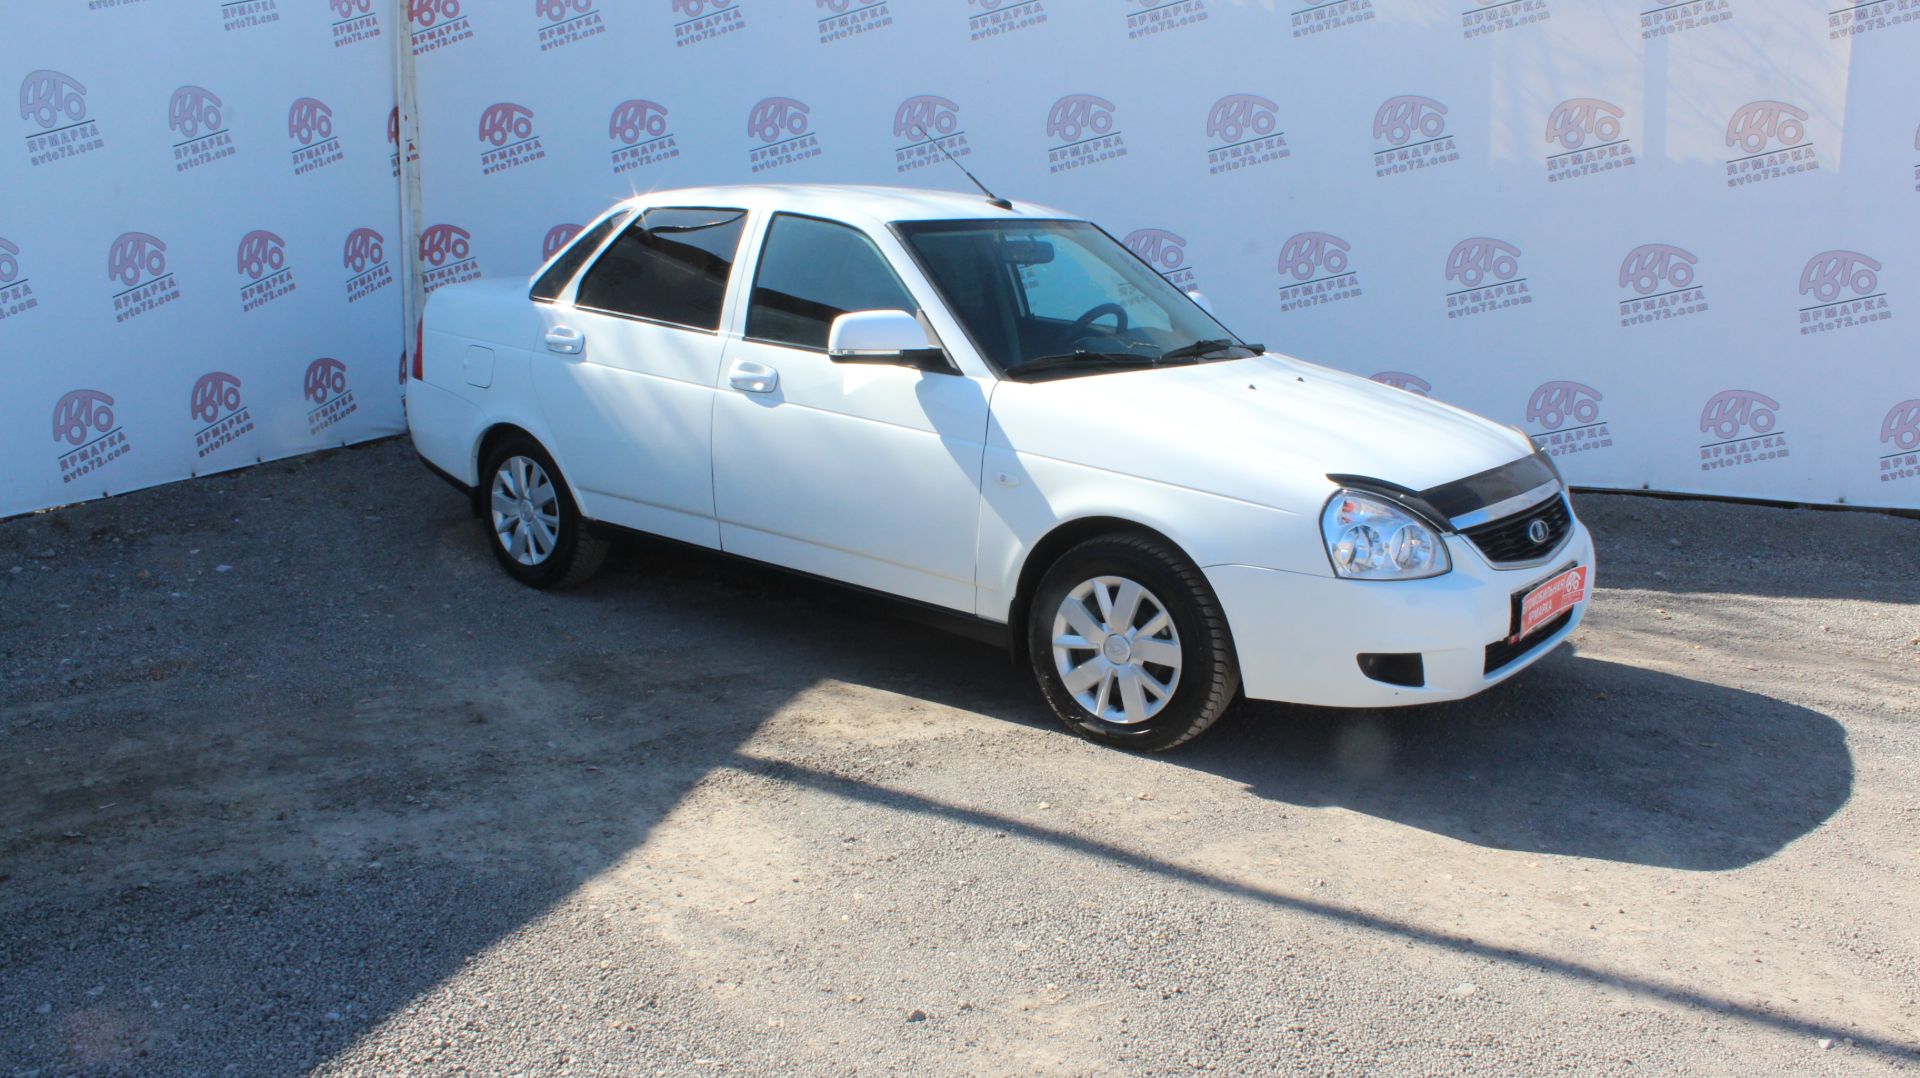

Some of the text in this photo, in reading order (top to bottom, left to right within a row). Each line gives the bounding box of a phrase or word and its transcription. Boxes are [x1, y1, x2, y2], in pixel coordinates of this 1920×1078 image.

[225, 12, 279, 31] avto72.com
[333, 16, 378, 36] ЯРМАРКА
[675, 9, 742, 37] ЯРМАРКА
[819, 6, 889, 34] ЯРМАРКА
[970, 3, 1043, 30] ЯРМАРКА
[971, 13, 1047, 41] avto72.com
[1127, 0, 1203, 29] ЯРМАРКА
[1129, 11, 1208, 39] avto72.com
[1291, 0, 1372, 27] ЯРМАРКА
[1293, 10, 1375, 38] avto72.com
[1462, 0, 1546, 27] ЯРМАРКА
[1464, 10, 1550, 38] avto72.com
[1640, 0, 1729, 28] ЯРМАРКА
[1642, 11, 1733, 39] avto72.com
[334, 28, 380, 47] avto72.com
[411, 20, 470, 46] ЯРМАРКА
[539, 14, 601, 41] ЯРМАРКА
[541, 25, 605, 50] avto72.com
[677, 20, 745, 47] avto72.com
[820, 17, 893, 43] avto72.com
[413, 30, 473, 56] avto72.com
[27, 124, 99, 152] ЯРМАРКА
[174, 133, 232, 160] ЯРМАРКА
[611, 138, 676, 164] ЯРМАРКА
[750, 136, 818, 162] ЯРМАРКА
[896, 135, 967, 163] ЯРМАРКА
[1049, 136, 1123, 162] ЯРМАРКА
[1209, 137, 1286, 164] ЯРМАРКА
[31, 138, 104, 166] avto72.com
[177, 145, 235, 172] avto72.com
[292, 141, 340, 164] ЯРМАРКА
[295, 151, 343, 175] avto72.com
[482, 140, 542, 166] ЯРМАРКА
[483, 150, 545, 175] avto72.com
[614, 148, 679, 174] avto72.com
[752, 147, 822, 173] avto72.com
[898, 147, 972, 173] avto72.com
[1050, 147, 1127, 174] avto72.com
[1210, 148, 1290, 175] avto72.com
[1375, 139, 1456, 166] ЯРМАРКА
[1377, 151, 1460, 178] avto72.com
[1547, 144, 1631, 170] ЯРМАРКА
[1727, 147, 1815, 175] ЯРМАРКА
[1549, 156, 1636, 183] avto72.com
[1728, 160, 1819, 188] avto72.com
[241, 272, 293, 300] ЯРМАРКА
[347, 266, 389, 293] ЯРМАРКА
[423, 261, 479, 285] ЯРМАРКА
[114, 278, 176, 310] ЯРМАРКА
[243, 283, 296, 312] avto72.com
[348, 276, 392, 302] avto72.com
[1280, 276, 1359, 302] ЯРМАРКА
[1281, 287, 1362, 312] avto72.com
[1447, 282, 1529, 307] ЯРМАРКА
[116, 289, 180, 322] avto72.com
[1448, 294, 1532, 318] avto72.com
[1620, 290, 1705, 316] ЯРМАРКА
[1621, 302, 1709, 327] avto72.com
[1801, 297, 1888, 324] ЯРМАРКА
[1801, 310, 1892, 335] avto72.com
[308, 393, 354, 425] ЯРМАРКА
[311, 403, 357, 434] avto72.com
[196, 412, 250, 447] ЯРМАРКА
[199, 422, 254, 457] avto72.com
[1538, 426, 1609, 449] РМАРКА
[59, 432, 126, 471] ЯРМАРКА
[1701, 436, 1785, 460] ЯРМАРКА
[1701, 448, 1789, 471] avto72.com
[63, 443, 130, 483] avto72.com
